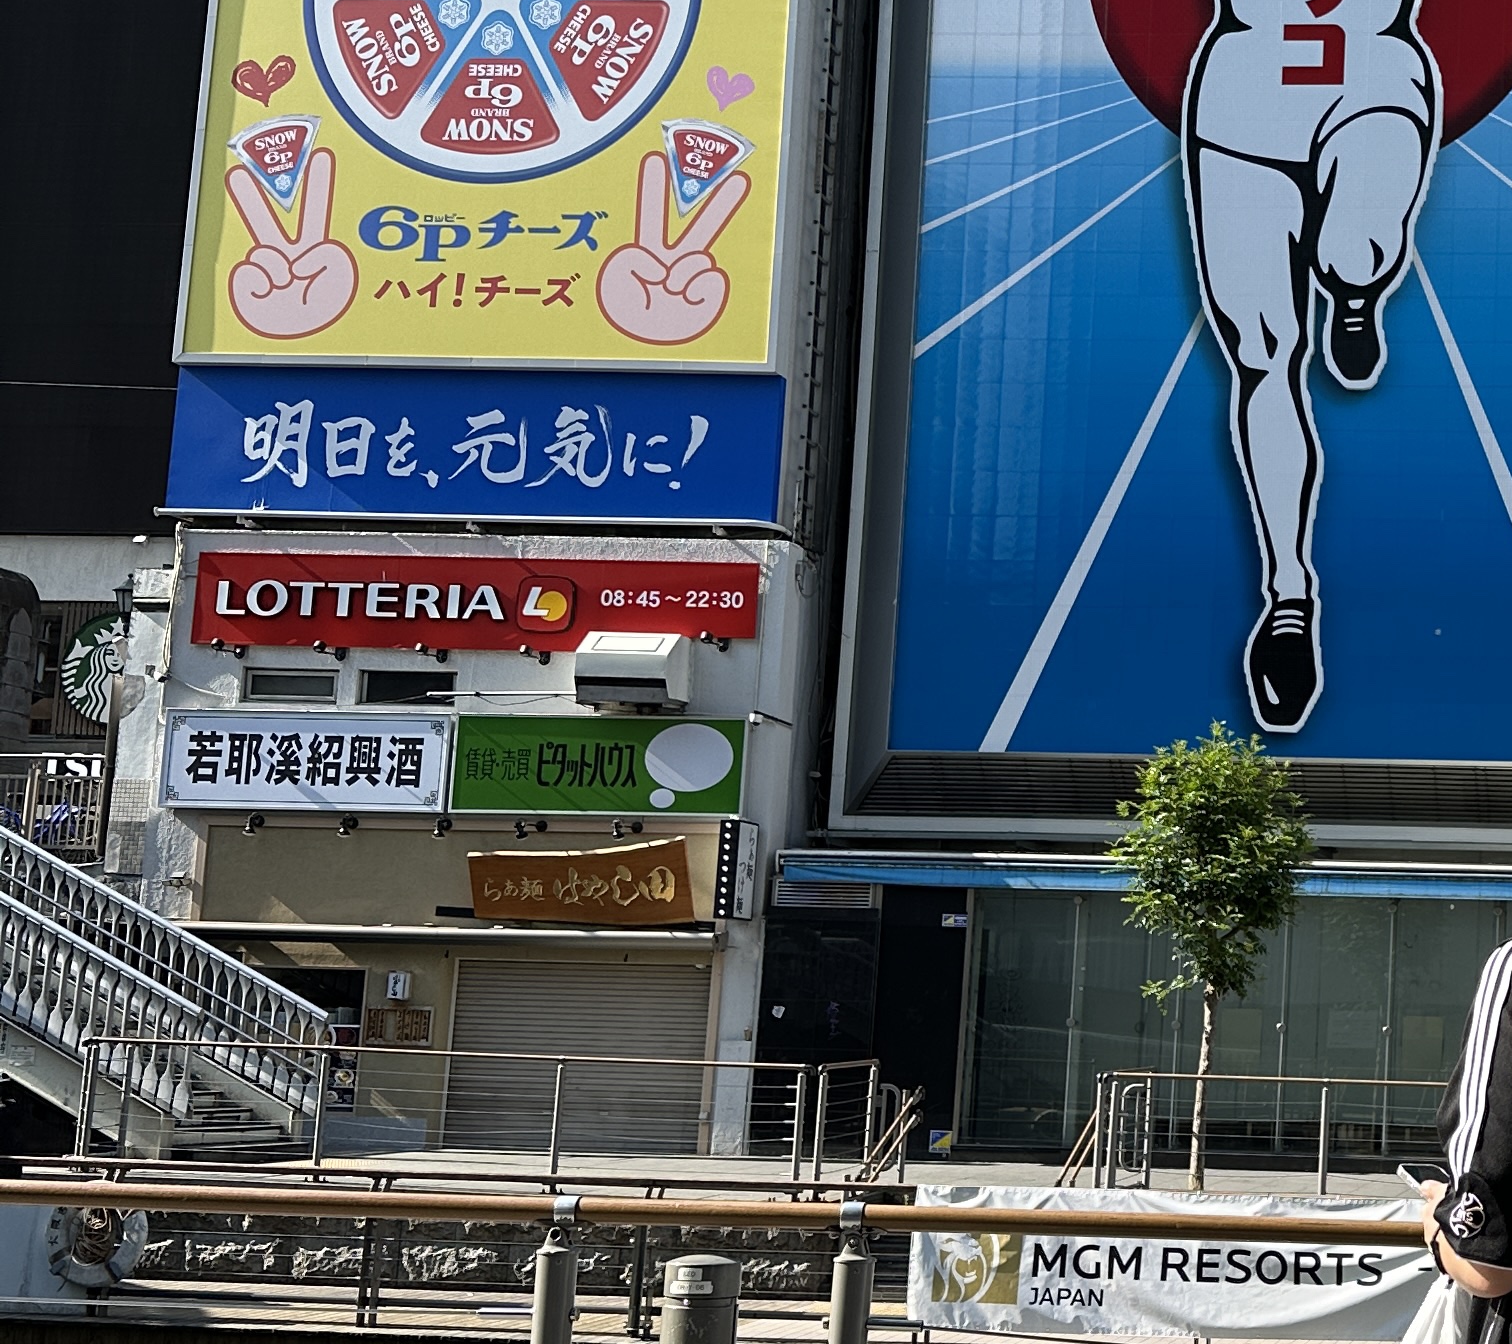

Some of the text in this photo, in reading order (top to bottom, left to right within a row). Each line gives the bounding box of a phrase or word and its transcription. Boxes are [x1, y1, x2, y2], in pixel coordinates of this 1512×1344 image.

[409, 2, 442, 53] CHEESE
[553, 3, 592, 55] CHEESE
[342, 17, 399, 98] SNOW
[468, 63, 523, 77] CHEESE
[590, 17, 655, 106] SNOW
[254, 128, 297, 151] SNOW
[441, 118, 535, 143] SNOW
[683, 133, 730, 155] SNOW
[215, 579, 506, 621] LOTTERIA
[536, 740, 638, 788] ピタットハウス
[552, 864, 676, 907] はやし田
[1030, 1242, 1384, 1288] MGM RESORTS
[1028, 1286, 1105, 1308] JAPAN
